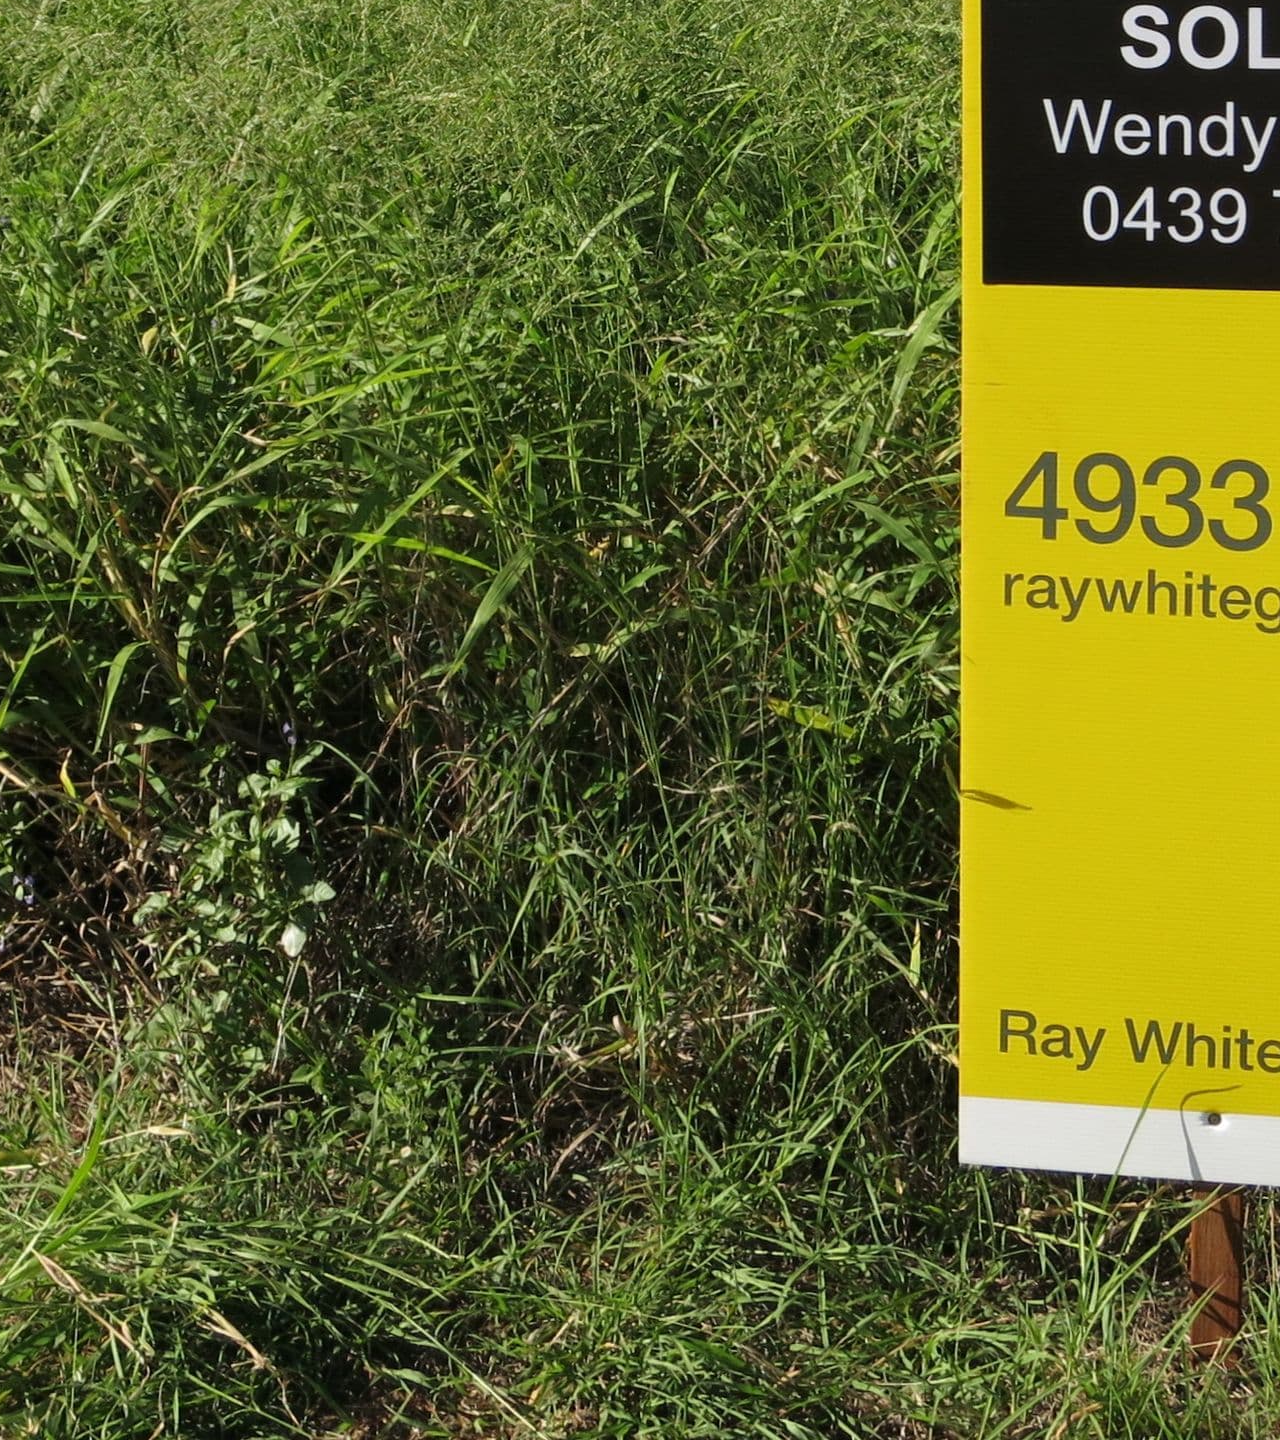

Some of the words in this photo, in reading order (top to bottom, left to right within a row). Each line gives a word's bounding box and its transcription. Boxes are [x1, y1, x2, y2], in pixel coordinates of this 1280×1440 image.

[1042, 98, 1277, 173] Wendy
[1082, 185, 1247, 244] 0439
[1004, 451, 1273, 552] 4933
[999, 1008, 1107, 1072] Ray
